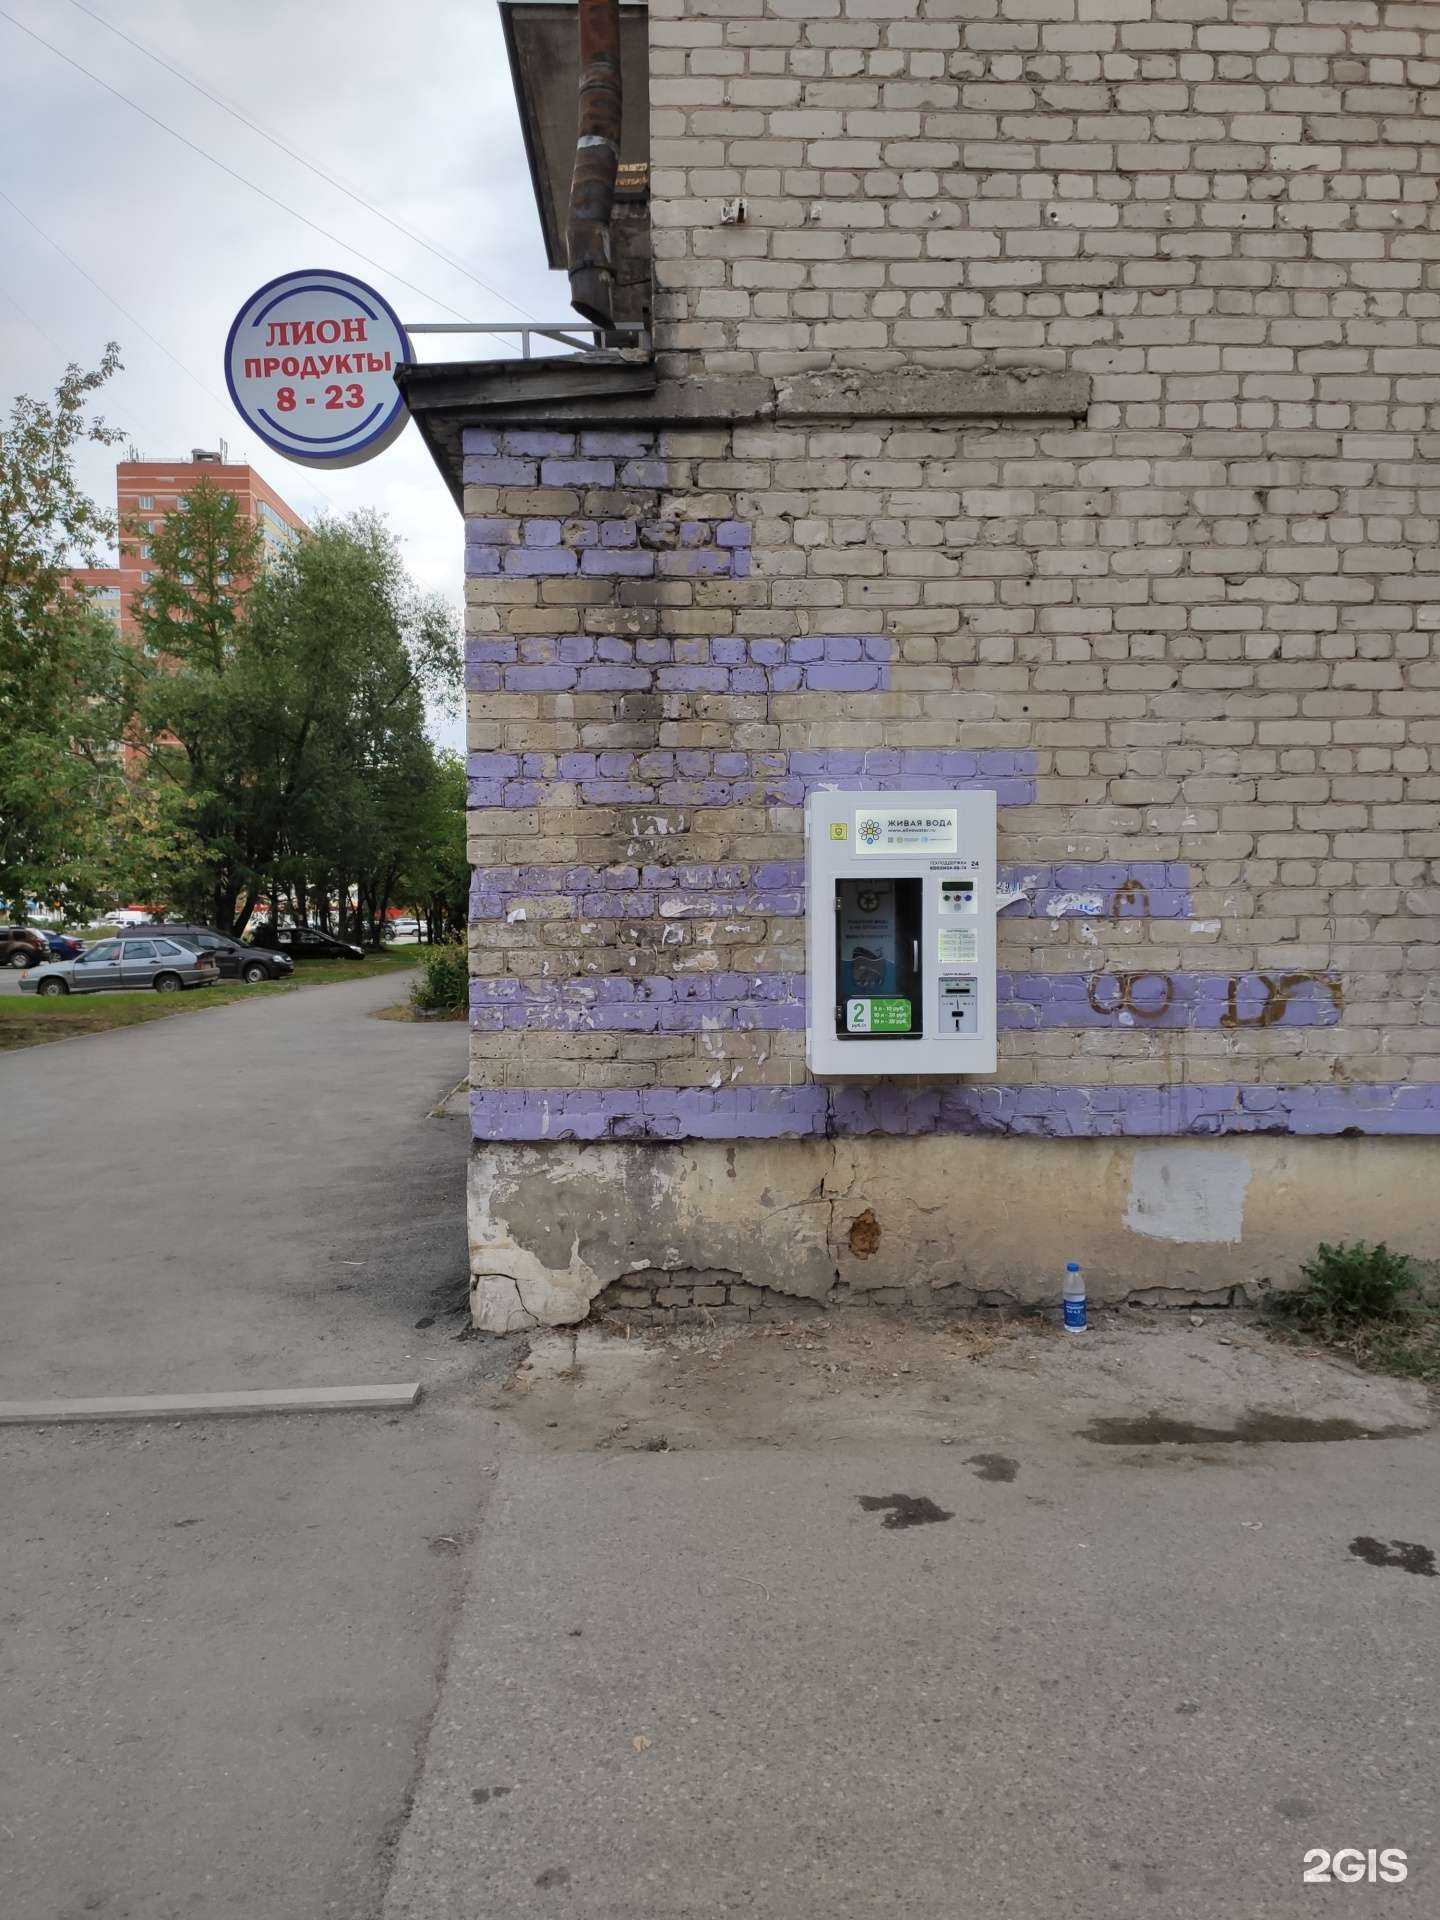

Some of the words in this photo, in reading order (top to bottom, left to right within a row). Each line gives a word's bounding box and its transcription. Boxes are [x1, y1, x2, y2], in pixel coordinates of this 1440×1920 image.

[266, 318, 368, 347] ЛИОН
[244, 352, 392, 380] ПРОДУКТЫ
[276, 387, 297, 412] 8
[324, 384, 365, 410] 23
[887, 819, 922, 827] ЖИВАЯ
[926, 819, 953, 827] ВОДА
[853, 1003, 865, 1023] 2
